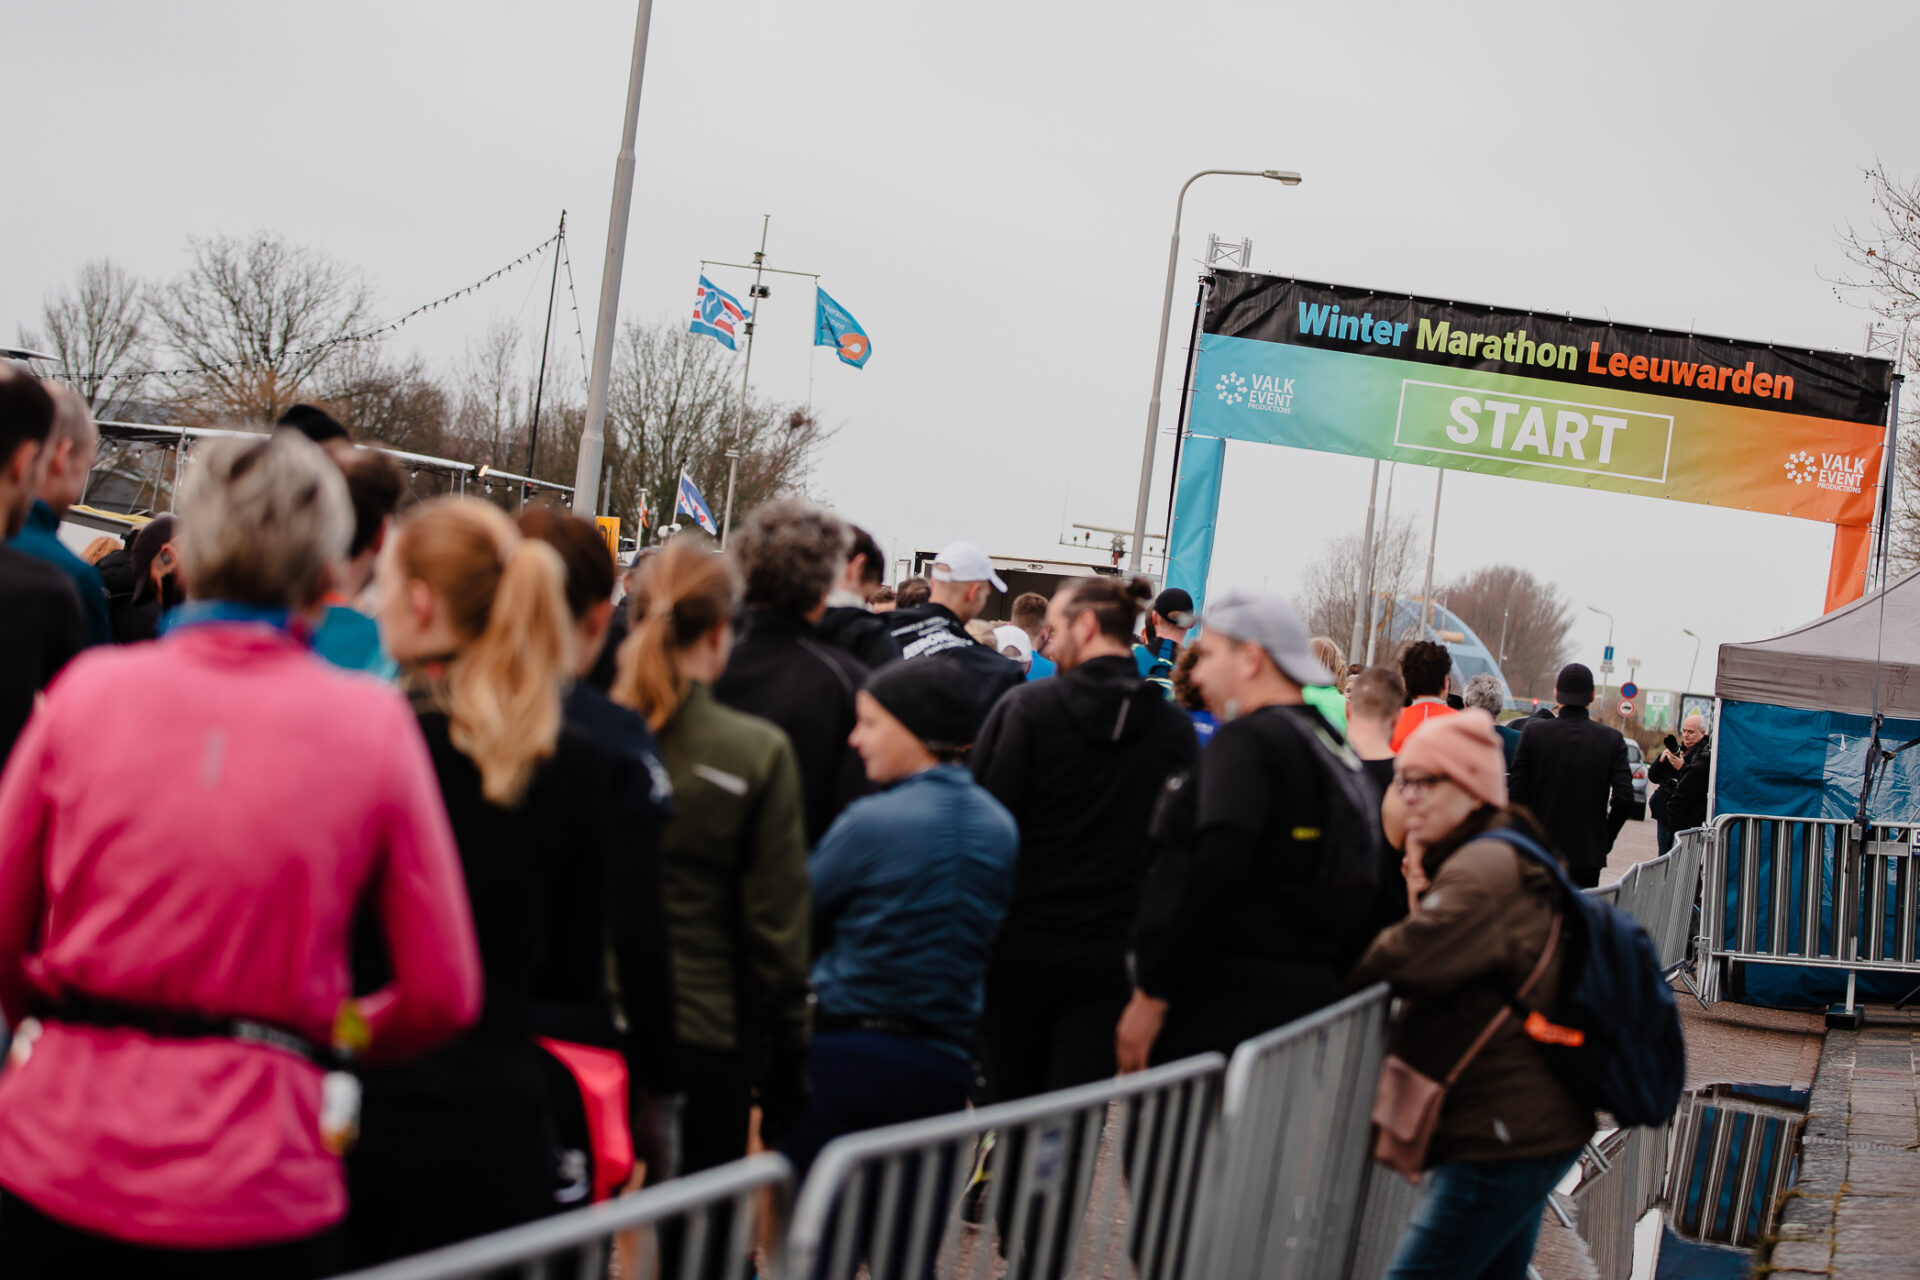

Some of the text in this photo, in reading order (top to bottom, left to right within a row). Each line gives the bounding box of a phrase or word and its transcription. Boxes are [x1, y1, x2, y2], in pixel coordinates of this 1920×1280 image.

[1298, 301, 1794, 400] Winter Marathon Leeuwarden
[1252, 373, 1296, 394] VALK
[1249, 390, 1294, 407] EVENT
[1247, 403, 1291, 415] PRODUCTIONS
[1445, 396, 1628, 464] START
[1821, 452, 1866, 474] VALK
[1817, 481, 1862, 494] PRODUCTIONS
[1819, 469, 1864, 487] EVENT
